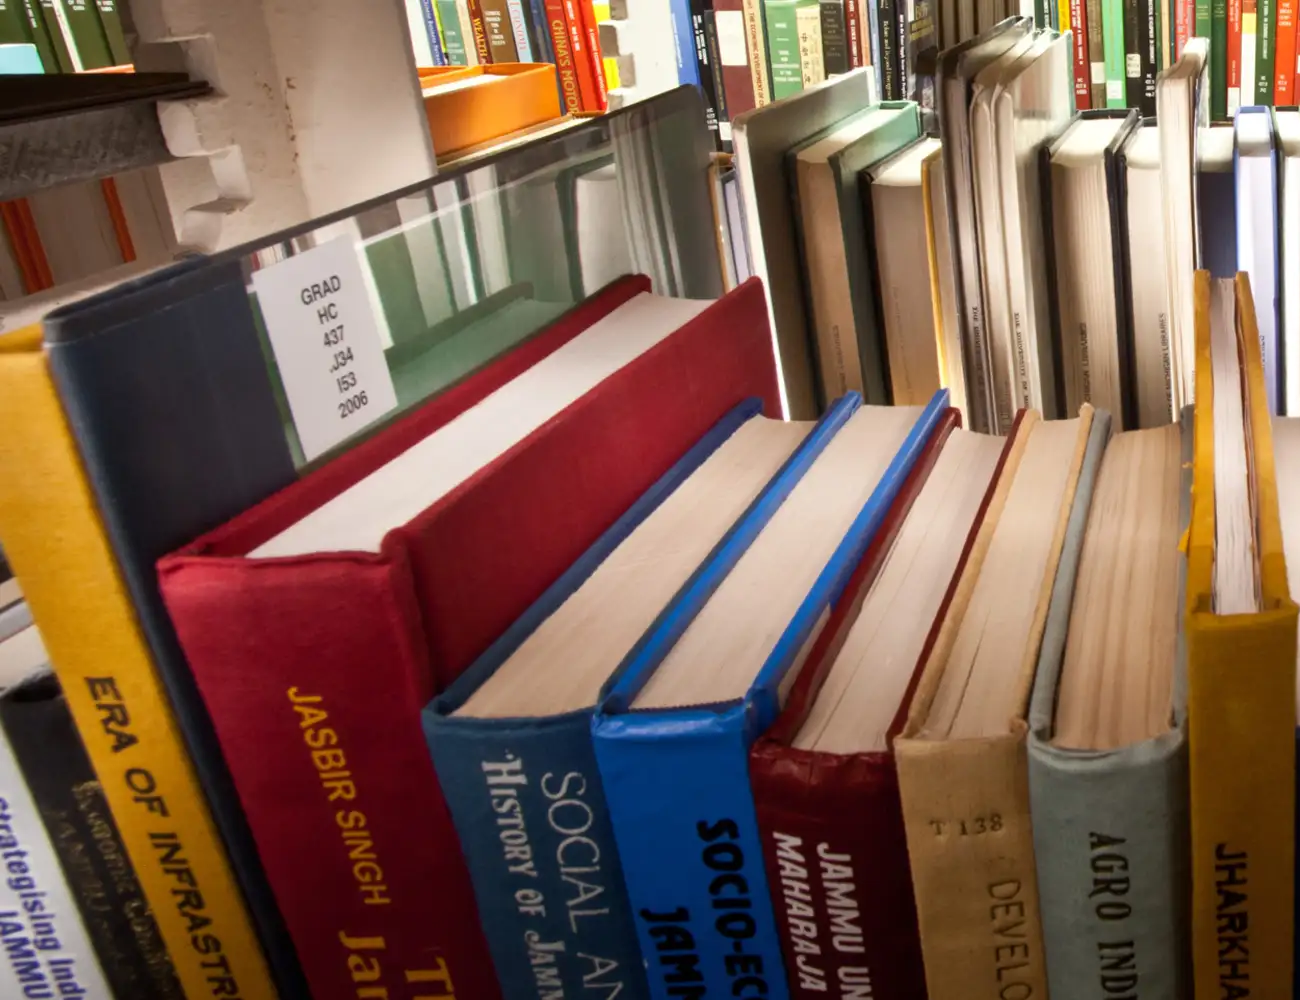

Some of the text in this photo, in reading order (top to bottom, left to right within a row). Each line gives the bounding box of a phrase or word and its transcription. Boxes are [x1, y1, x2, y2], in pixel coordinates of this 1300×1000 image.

[473, 18, 489, 57] WEALTH
[552, 20, 571, 67] CHINA'S
[301, 275, 342, 305] GRAD
[317, 303, 339, 325] HC
[323, 325, 345, 348] 437
[1159, 313, 1169, 352] LIBRARIES
[338, 391, 369, 419] 2006
[83, 675, 139, 754] ERA
[124, 767, 170, 817] OF
[287, 686, 391, 905] JASBIR SINGH
[481, 759, 538, 878] HISTORY
[514, 889, 546, 918] OF
[958, 813, 1003, 836] 138
[541, 771, 610, 933] SOCIAL
[696, 818, 768, 1000] SOCIO-EC
[772, 831, 828, 992] MAHARAJA
[816, 842, 866, 953] JAMMU
[1088, 831, 1139, 1000] AGRO IND
[48, 958, 86, 1000] Ind
